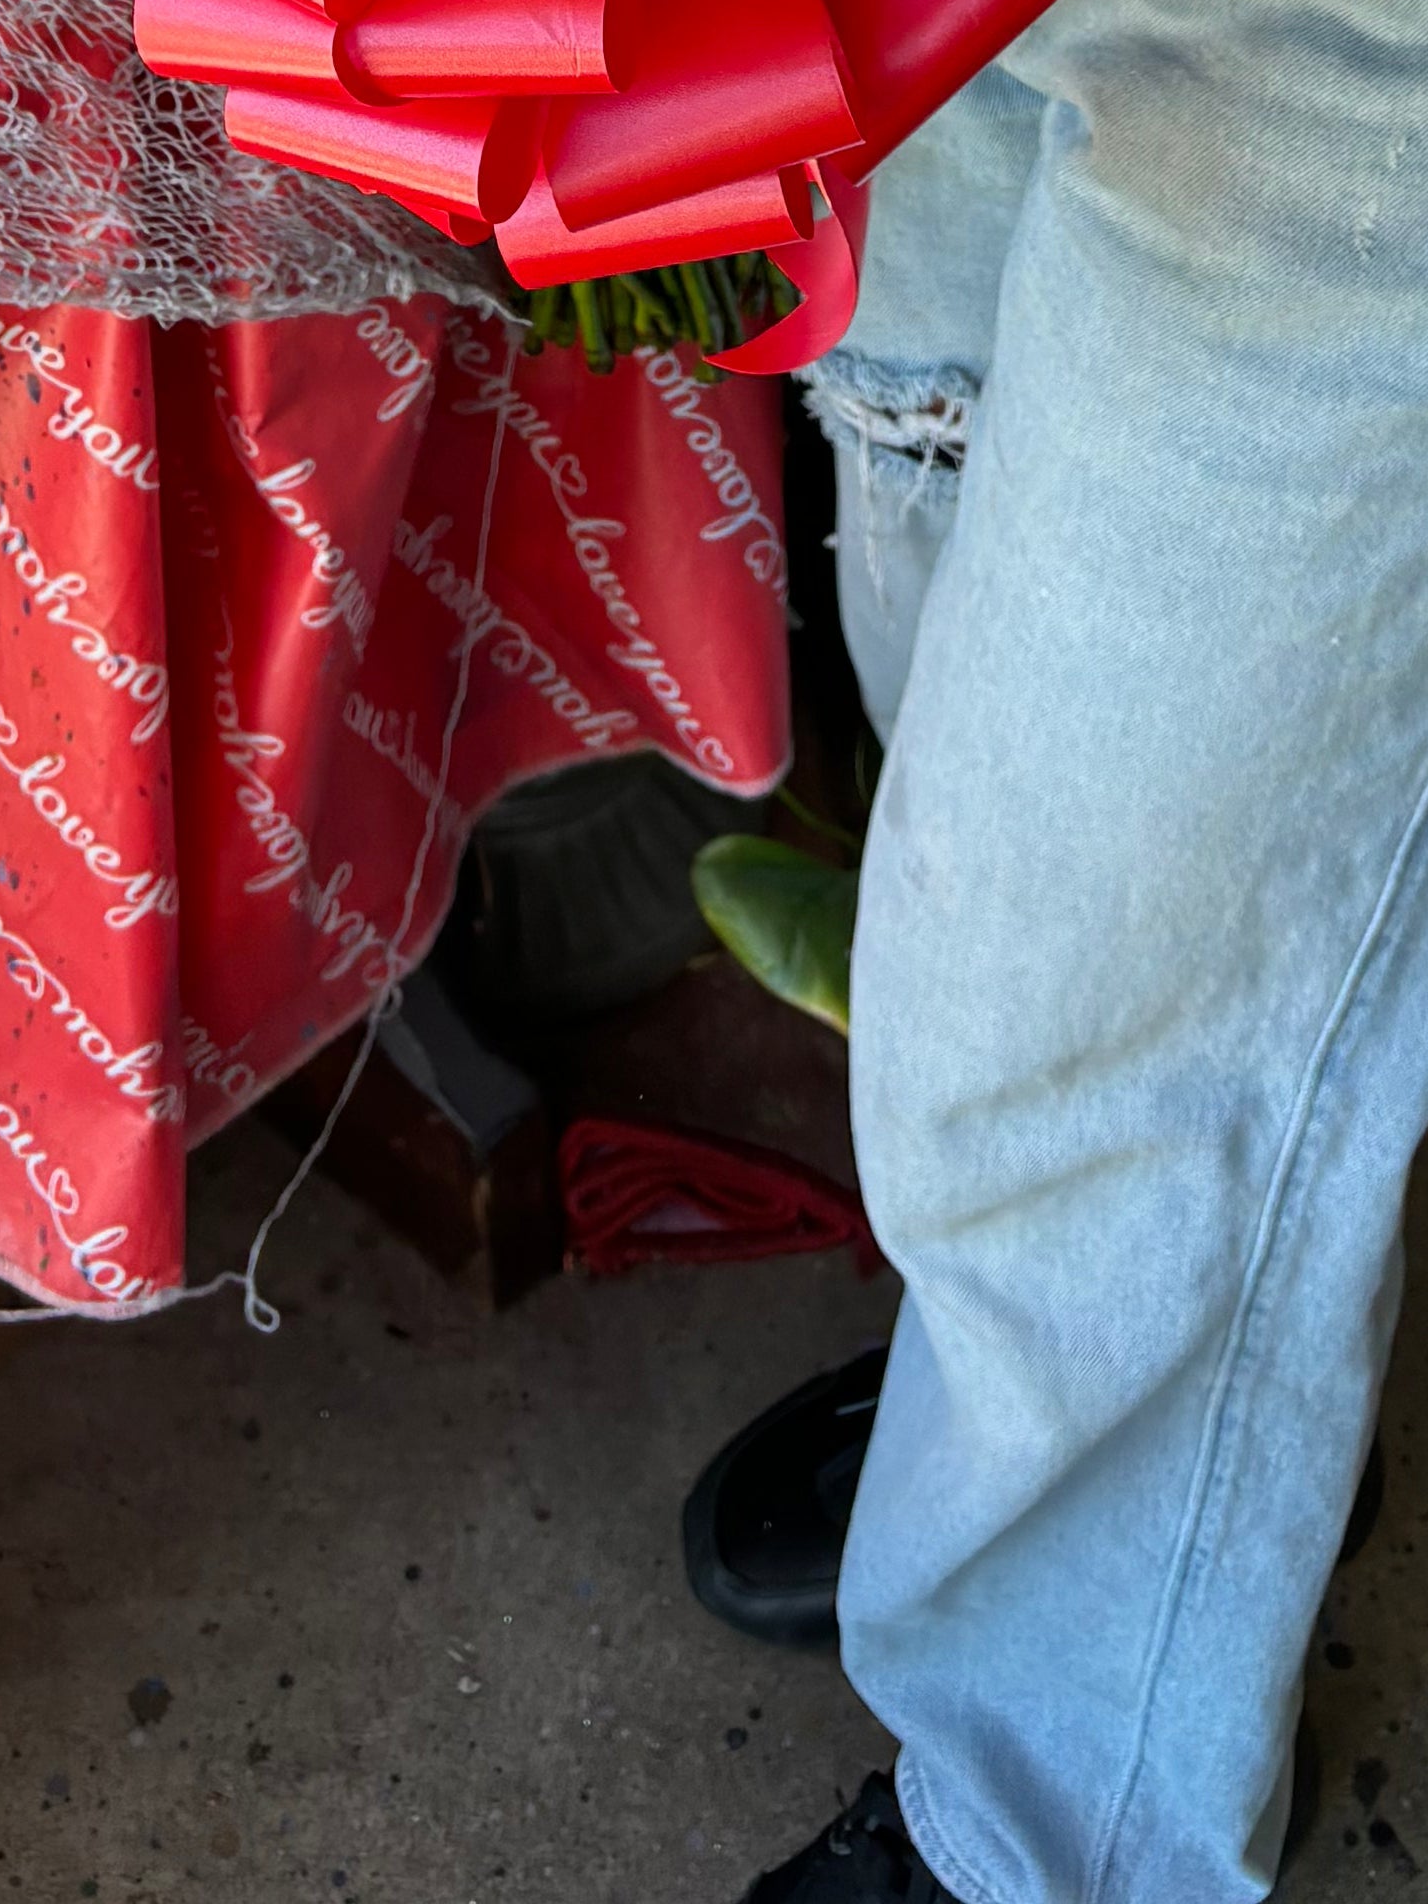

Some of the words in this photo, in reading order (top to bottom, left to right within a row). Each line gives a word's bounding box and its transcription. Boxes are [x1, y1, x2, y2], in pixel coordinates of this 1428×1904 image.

[47, 388, 161, 492] you
[685, 420, 759, 542] love
[568, 517, 642, 632] love
[605, 636, 701, 736] you
[72, 632, 171, 745] love
[20, 754, 122, 871] love
[54, 990, 164, 1097] you
